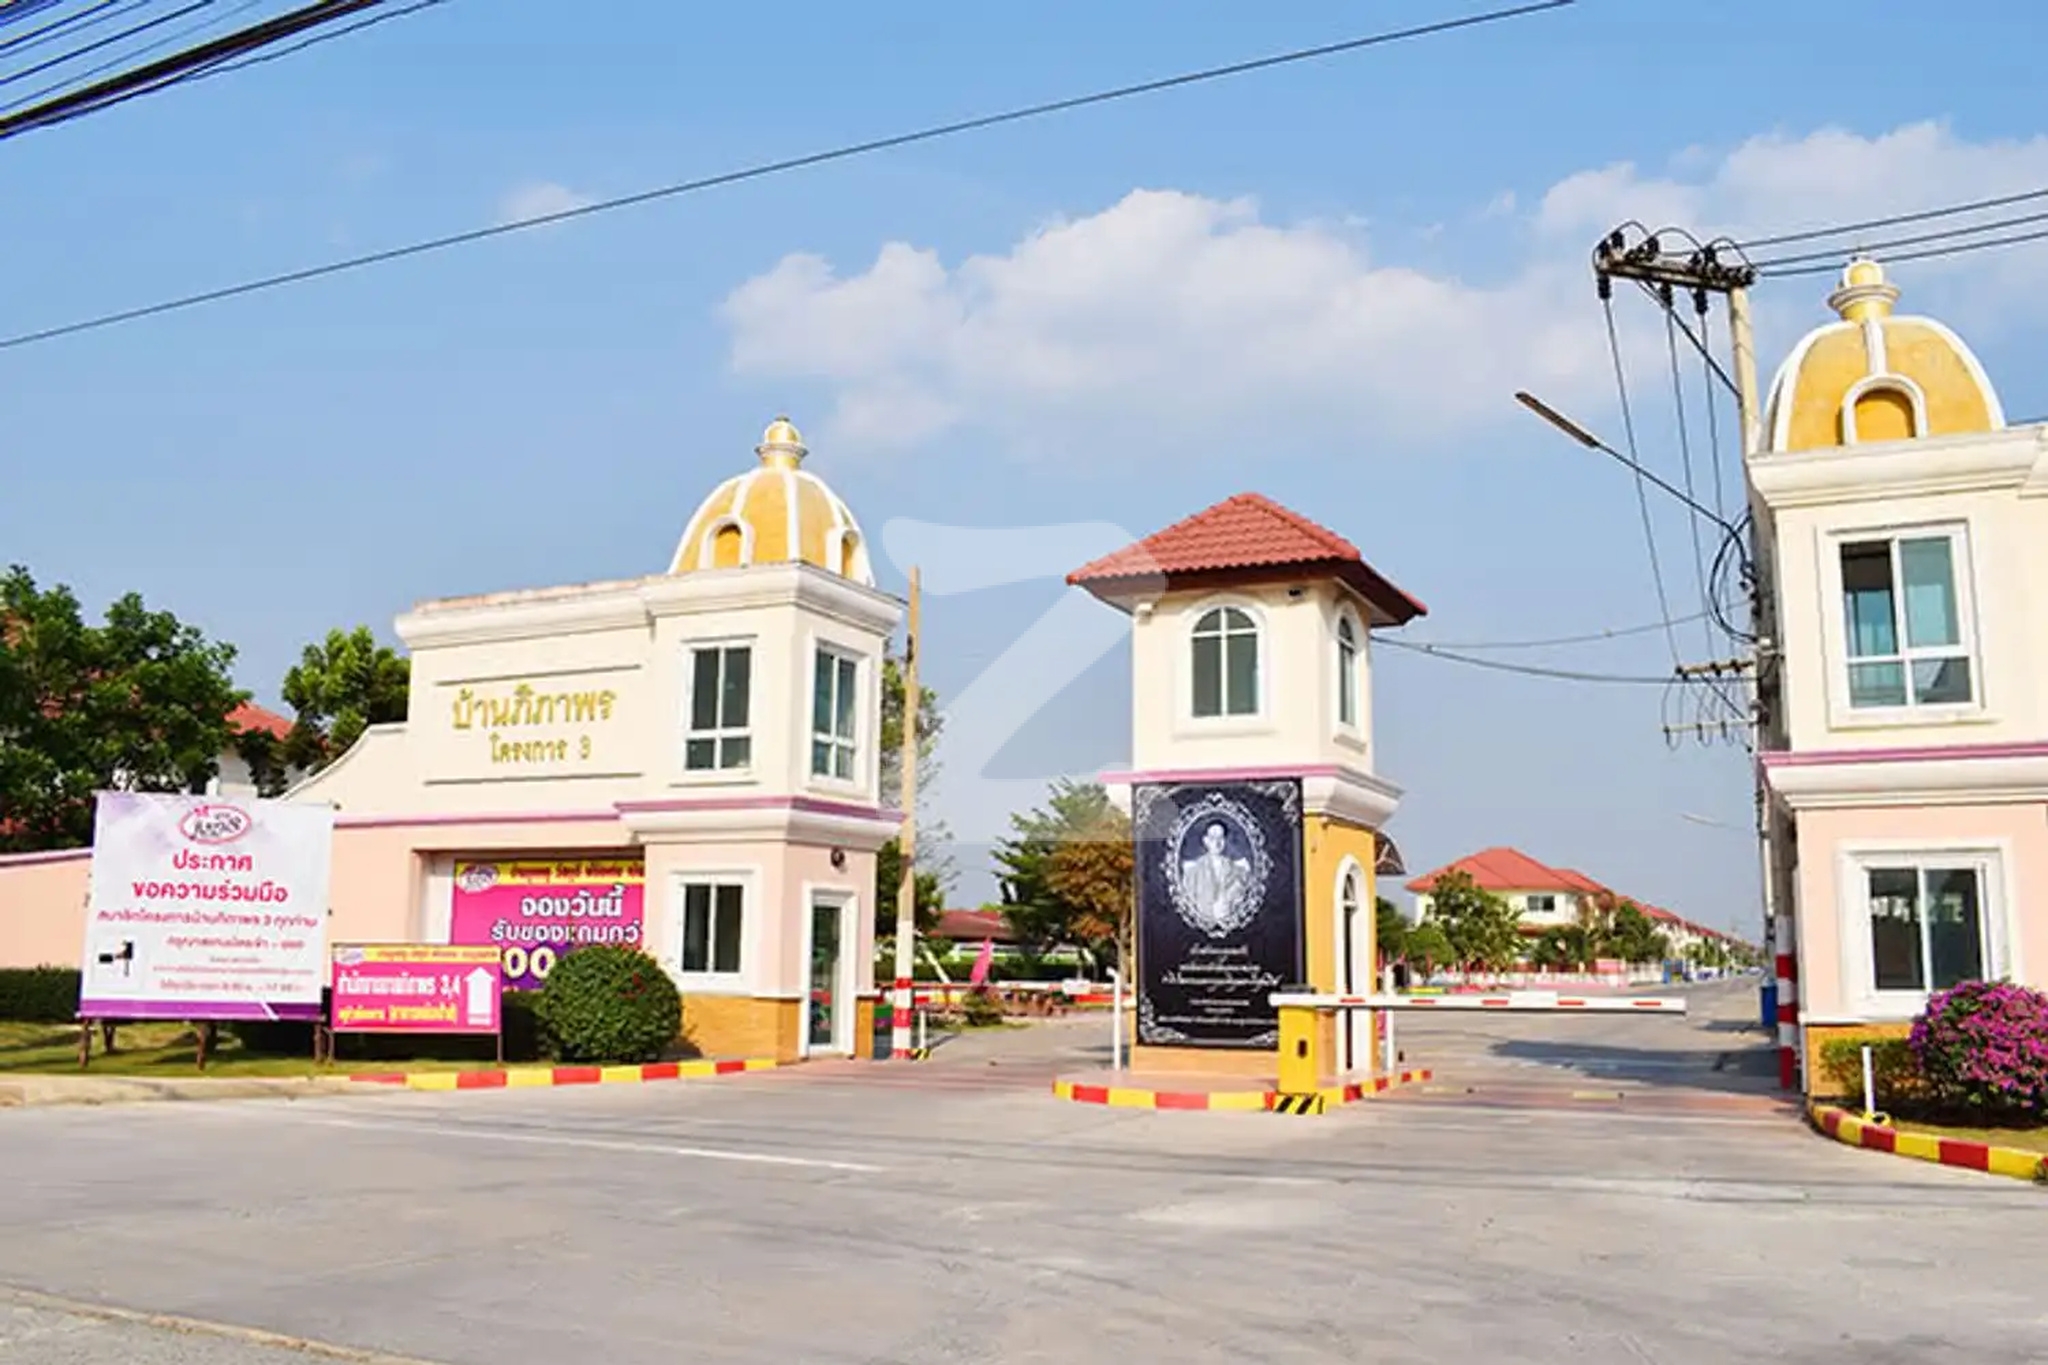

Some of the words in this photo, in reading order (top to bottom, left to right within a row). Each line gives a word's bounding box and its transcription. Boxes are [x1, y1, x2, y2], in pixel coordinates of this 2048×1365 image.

[579, 734, 592, 760] 3
[172, 848, 254, 872] ประกาศ
[131, 878, 289, 903] ขอความร่วมมือ
[521, 883, 626, 917] จองวันนี้
